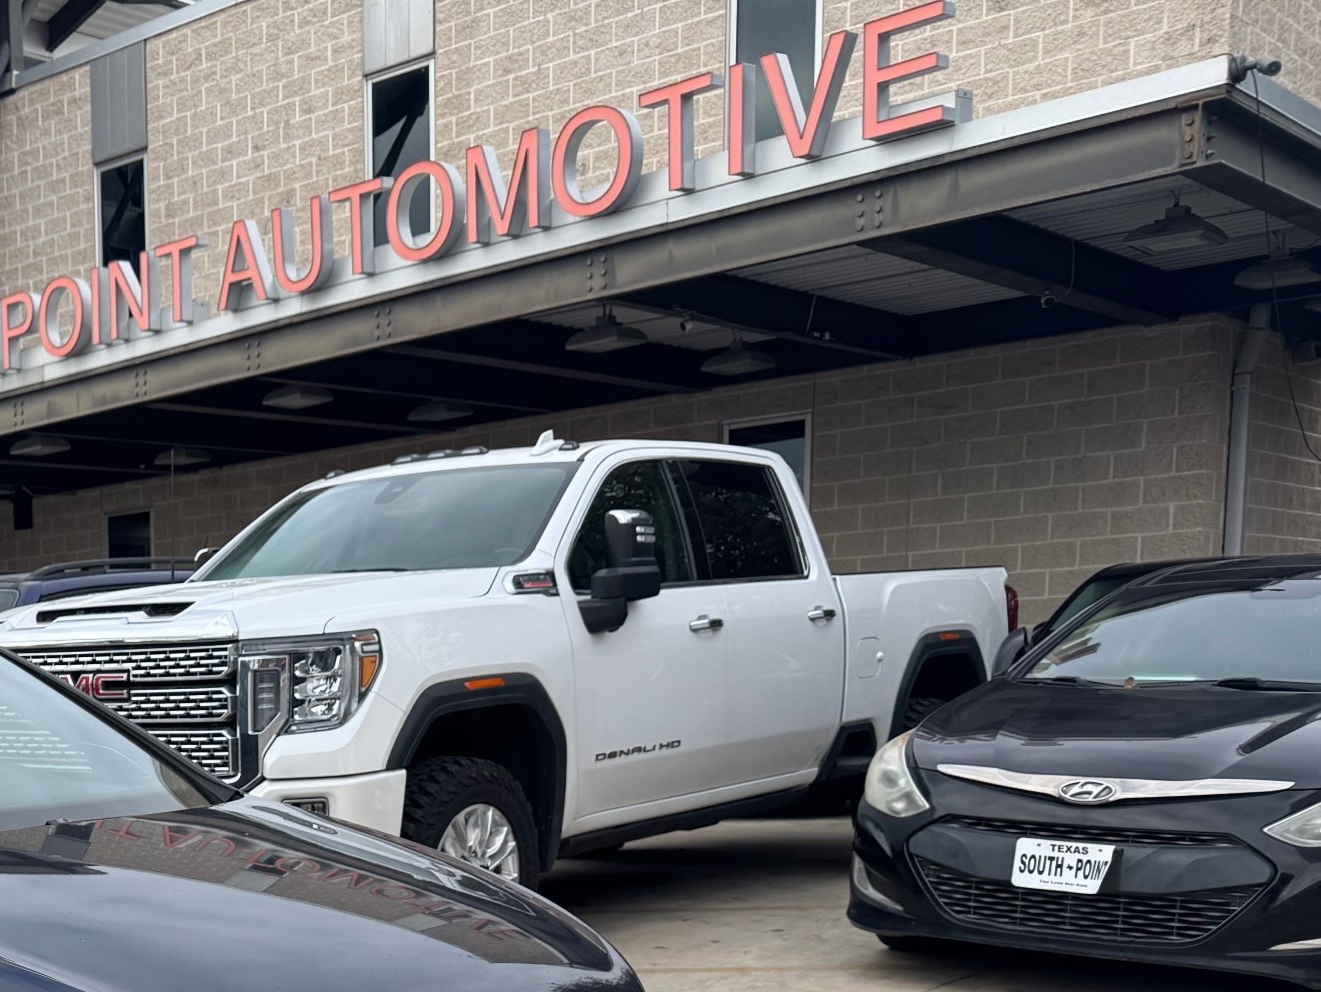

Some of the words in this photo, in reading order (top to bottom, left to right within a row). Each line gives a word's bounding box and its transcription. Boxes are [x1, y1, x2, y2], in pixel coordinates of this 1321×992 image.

[217, 1, 954, 312] AUTOMOTIVE
[57, 673, 128, 698] MC
[595, 744, 657, 762] DENALI
[658, 740, 682, 750] HD
[1050, 843, 1089, 855] TEXAS
[1019, 853, 1064, 877] SOUTH
[1074, 858, 1109, 880] POINT
